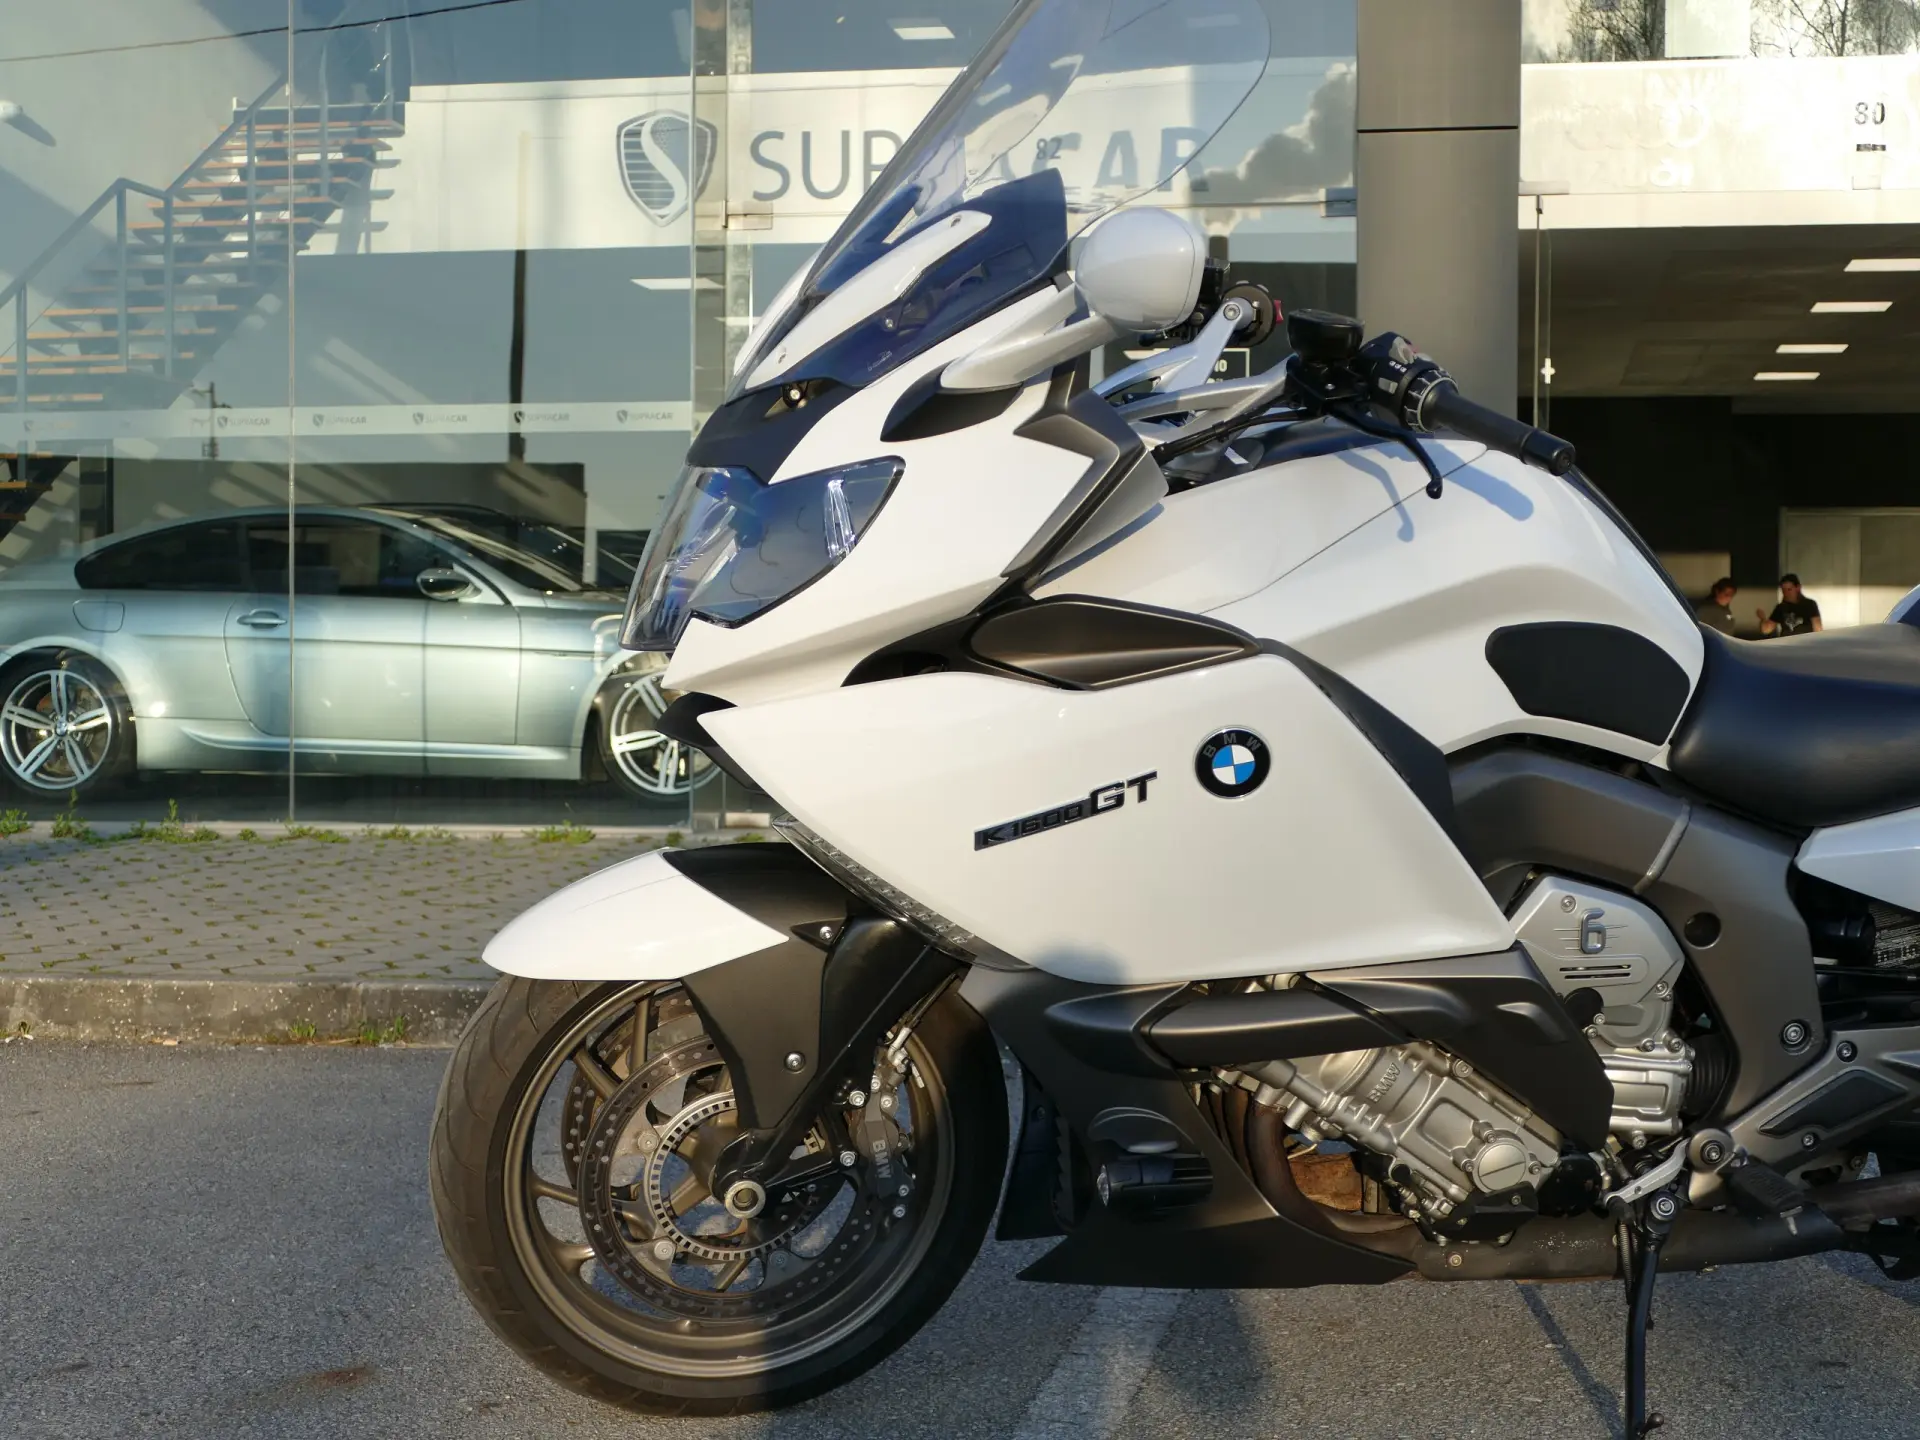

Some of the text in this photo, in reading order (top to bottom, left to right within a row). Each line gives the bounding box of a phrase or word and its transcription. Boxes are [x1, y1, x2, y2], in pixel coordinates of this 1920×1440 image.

[1202, 732, 1262, 759] BMW
[1367, 1062, 1402, 1104] BMW
[873, 1139, 891, 1178] BMW
